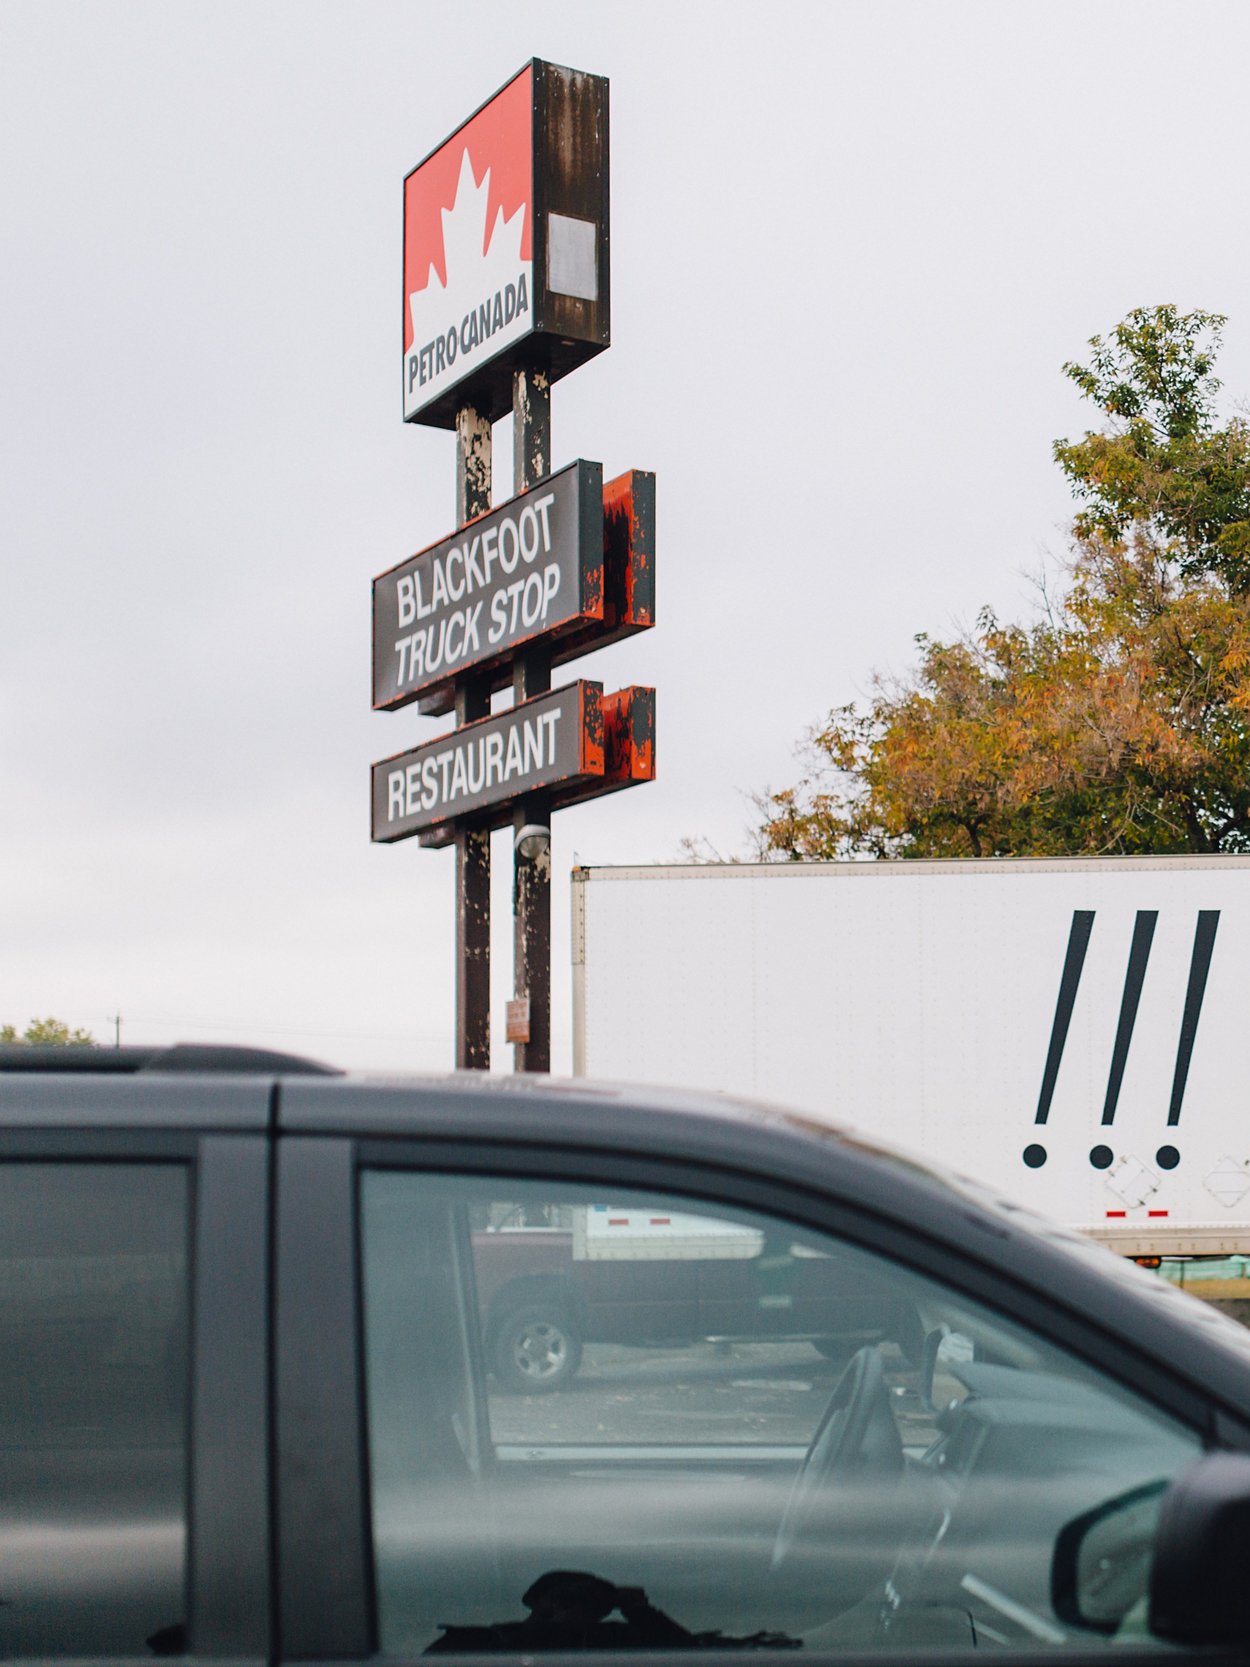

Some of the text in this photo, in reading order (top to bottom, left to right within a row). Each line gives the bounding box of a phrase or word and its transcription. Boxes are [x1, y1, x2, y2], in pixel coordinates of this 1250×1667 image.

[396, 494, 555, 629] BLACKFOOT
[394, 564, 560, 687] TRUCK STOP
[387, 708, 561, 822] RESTAURANT
